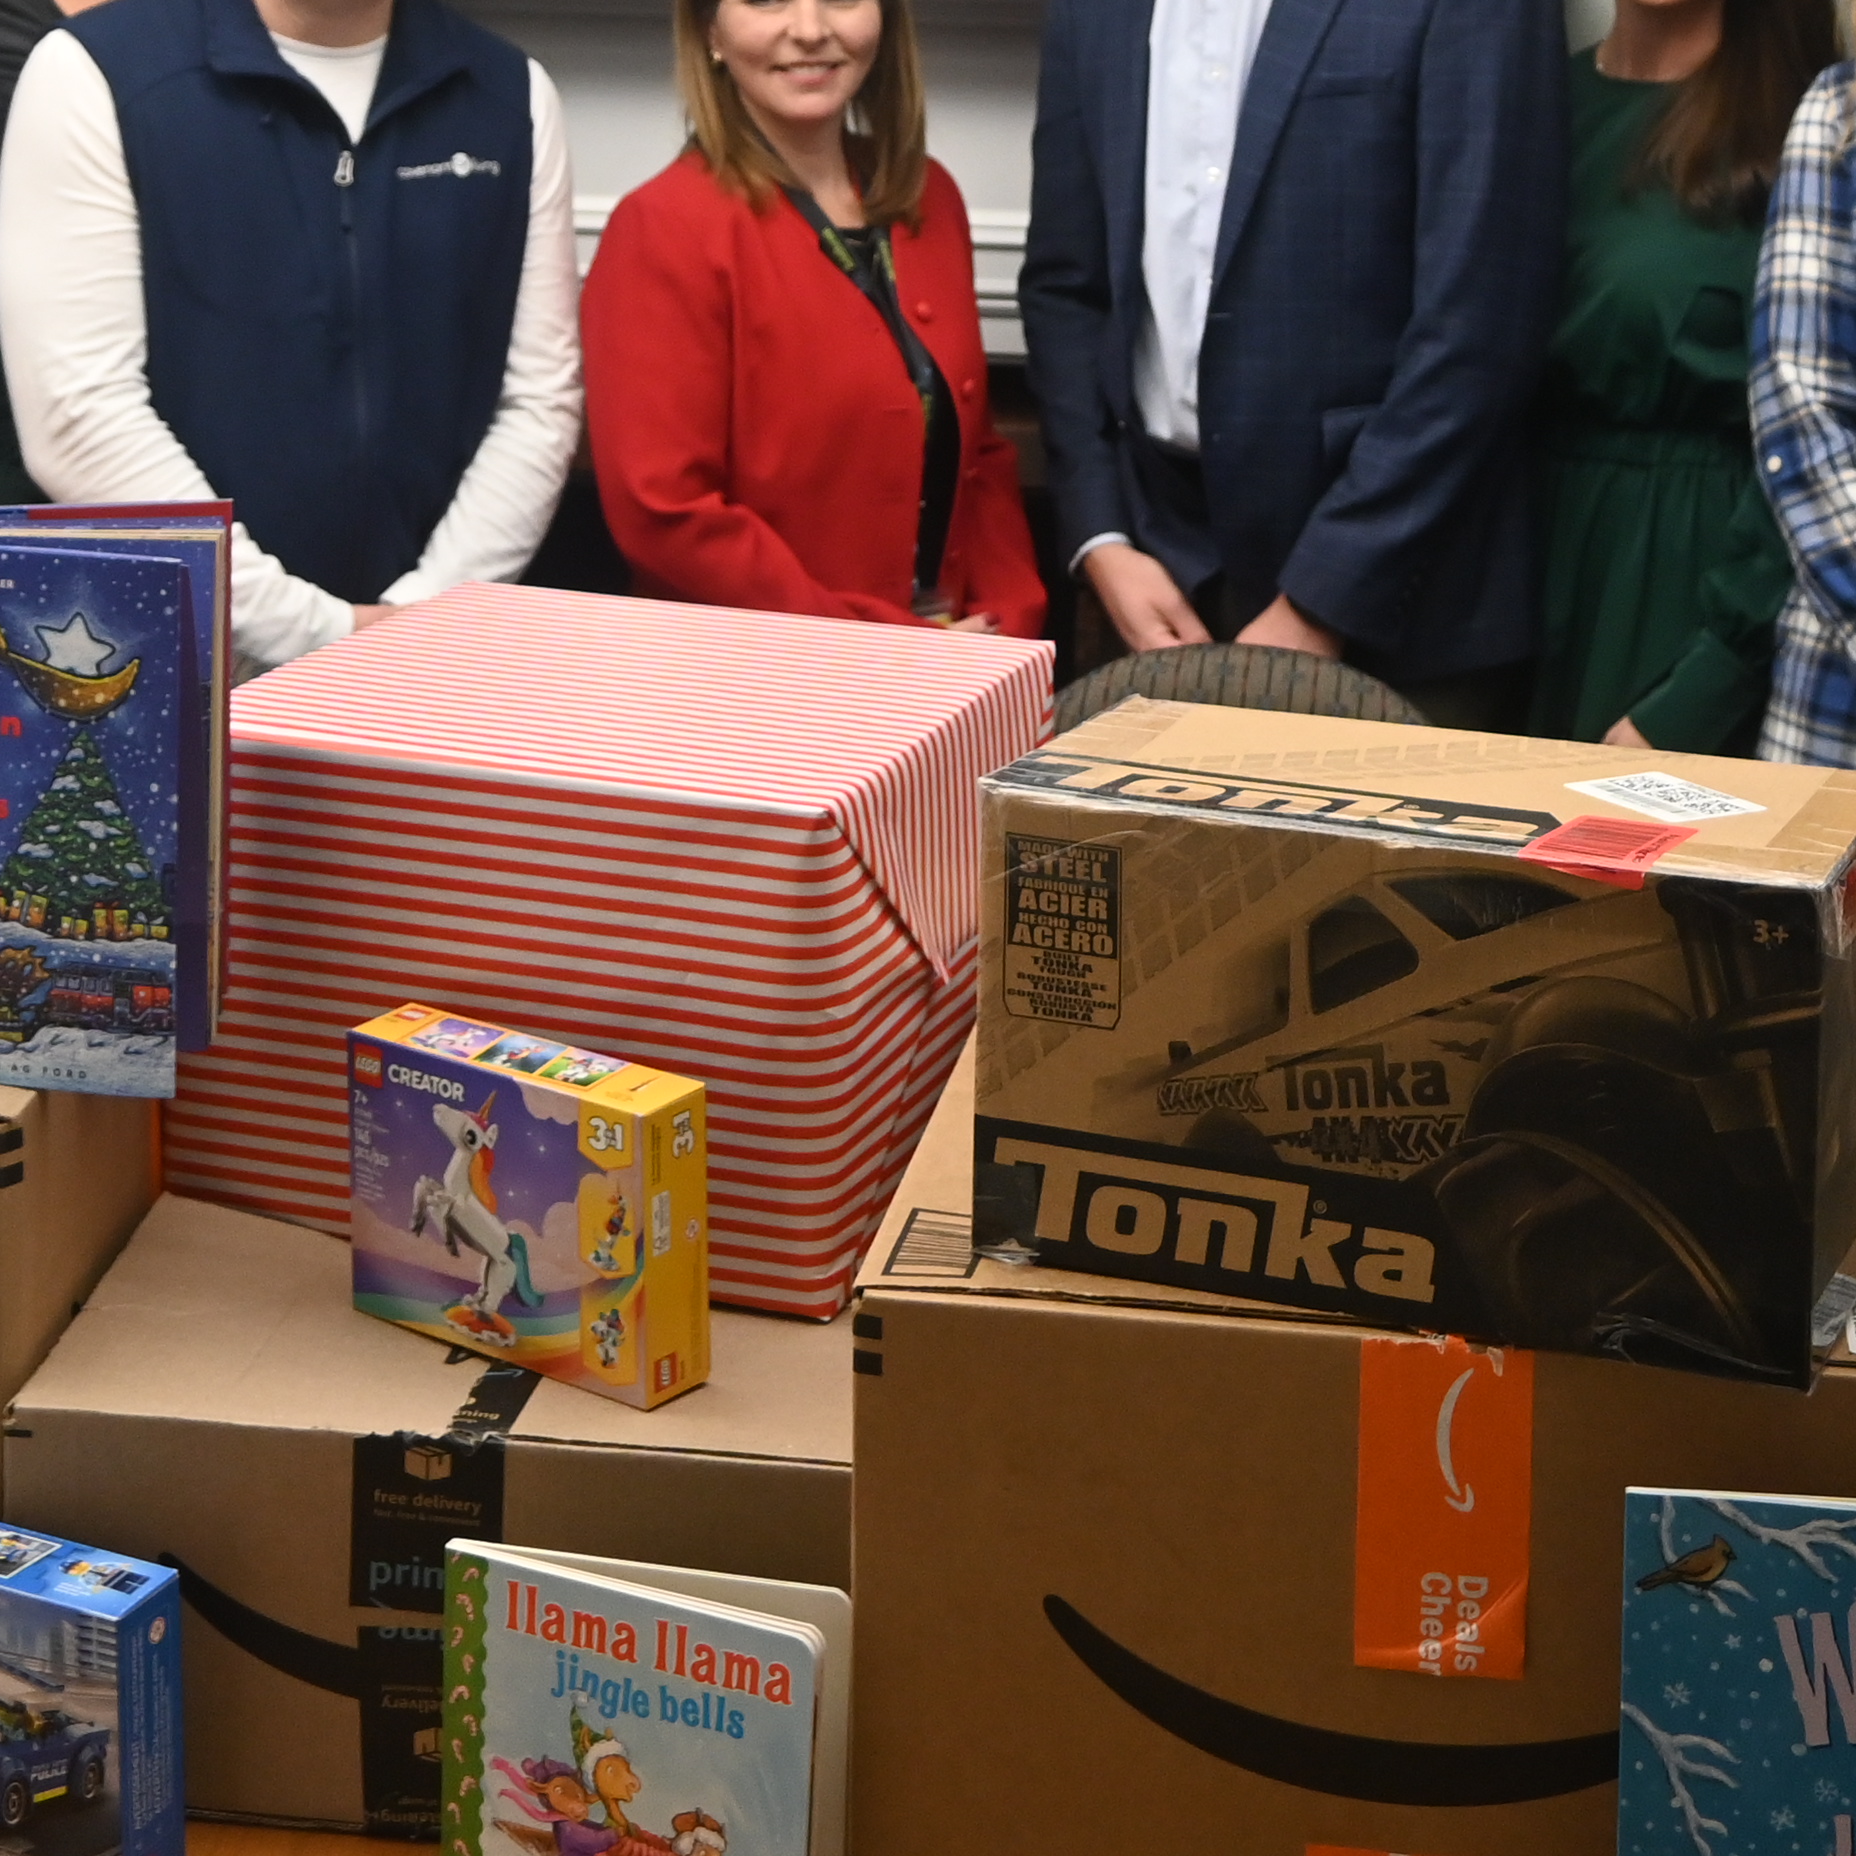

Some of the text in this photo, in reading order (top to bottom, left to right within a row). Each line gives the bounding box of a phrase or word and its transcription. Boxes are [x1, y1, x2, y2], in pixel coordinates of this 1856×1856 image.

[1038, 755, 1544, 841] Tonka
[1019, 851, 1107, 883] STEEL
[1067, 847, 1109, 862] WITH
[1018, 888, 1108, 919] ACIER
[1011, 922, 1114, 956] ACERO
[1019, 912, 1108, 934] HECHO CON
[1753, 919, 1790, 944] 3+
[1031, 955, 1094, 974] TONKA
[1031, 1006, 1093, 1023] TONKA
[355, 1055, 381, 1074] LEGO
[1265, 1044, 1450, 1111] Tonka
[388, 1063, 465, 1102] CREATOR
[994, 1136, 1435, 1304] Tonka
[373, 1488, 483, 1517] free delivery
[1417, 1571, 1452, 1678] Cheer
[1454, 1575, 1490, 1672] Deals
[505, 1580, 793, 1707] llama llama
[381, 1694, 443, 1713] elivery
[551, 1650, 746, 1740] jingle bells
